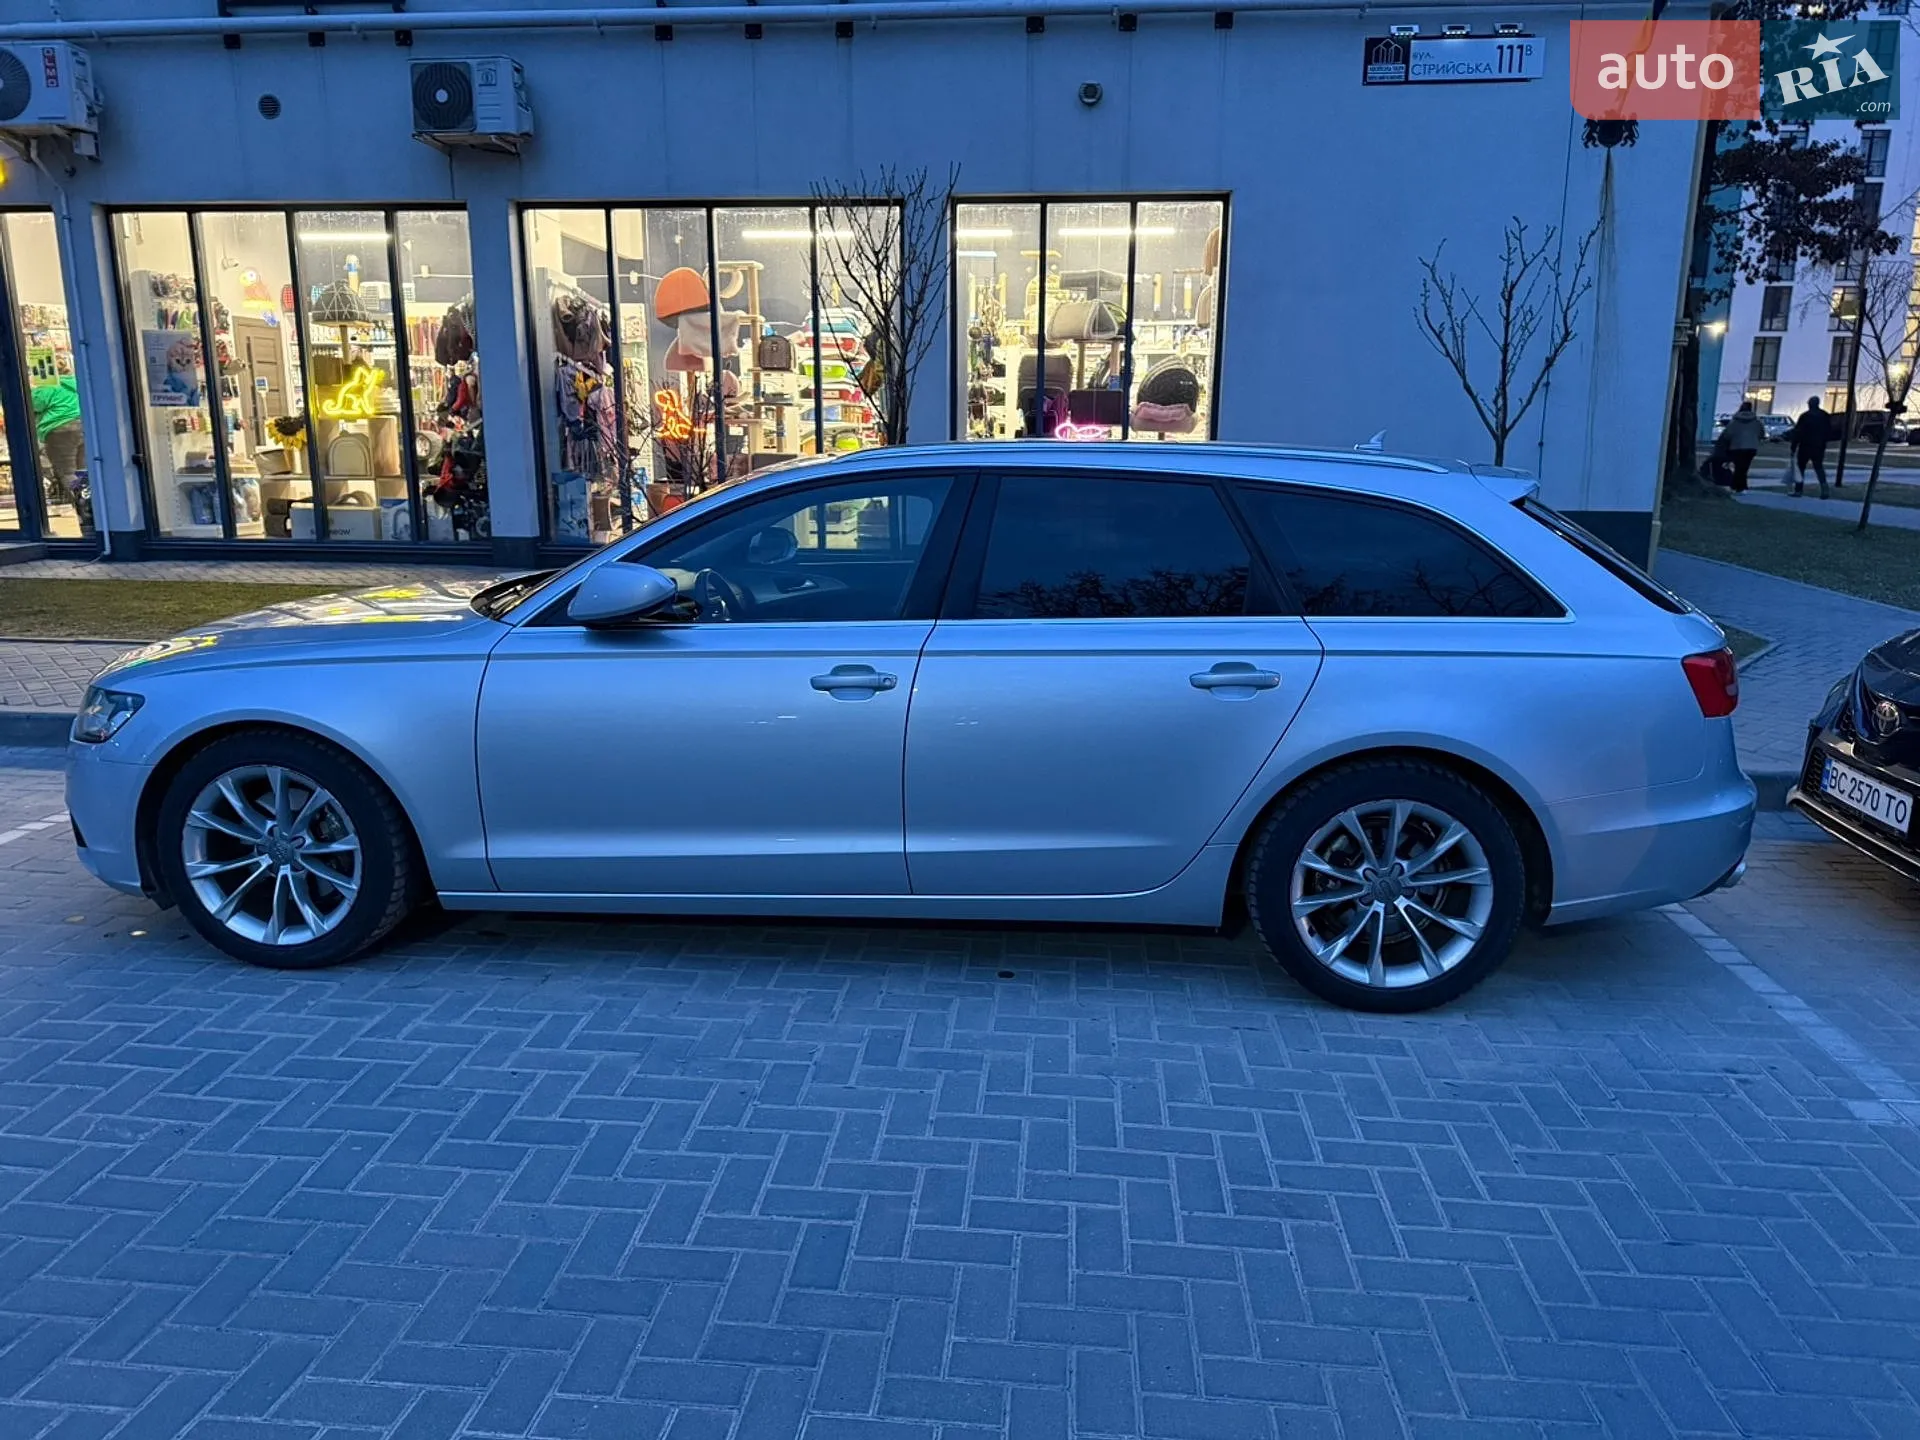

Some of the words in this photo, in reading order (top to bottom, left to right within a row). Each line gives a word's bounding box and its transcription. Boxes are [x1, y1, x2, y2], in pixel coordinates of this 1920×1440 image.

[1412, 52, 1435, 61] вул.
[1411, 61, 1493, 76] СТРИЙСЬКА
[1829, 766, 1848, 794] BC
[1848, 777, 1881, 811] 2570
[1885, 792, 1907, 824] TO
